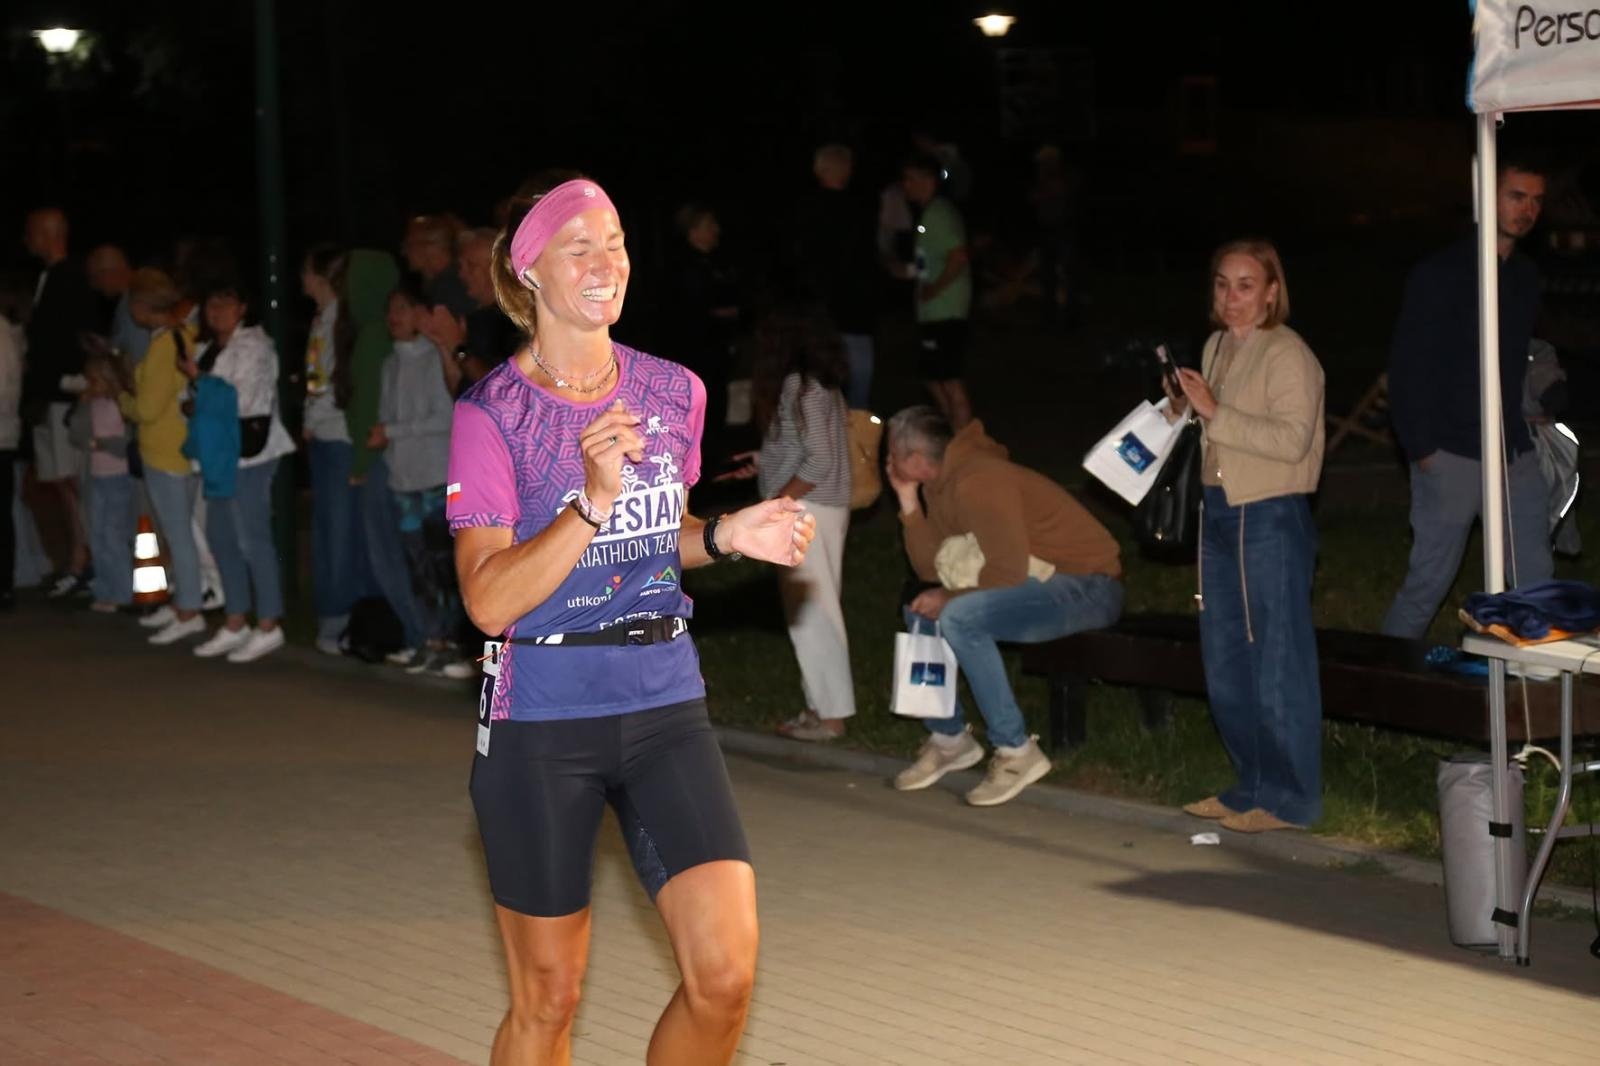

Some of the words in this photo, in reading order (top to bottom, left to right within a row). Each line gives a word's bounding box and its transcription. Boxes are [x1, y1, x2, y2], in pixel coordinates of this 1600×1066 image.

[1514, 4, 1600, 49] Perso
[600, 490, 681, 536] ESIAN
[576, 540, 649, 569] RIATHLON
